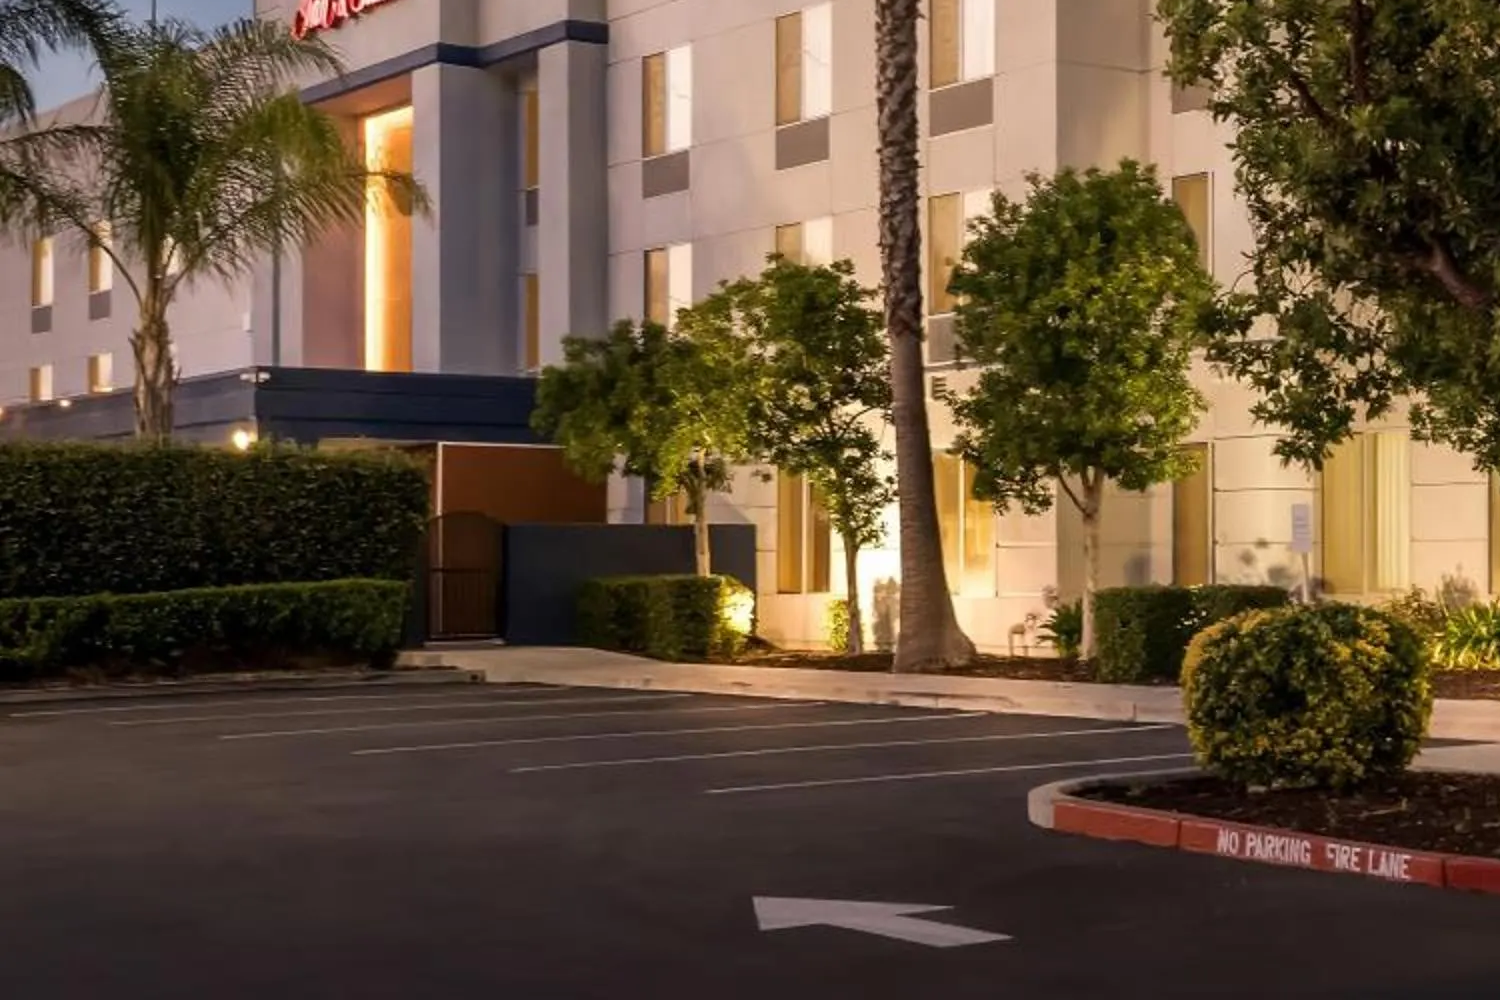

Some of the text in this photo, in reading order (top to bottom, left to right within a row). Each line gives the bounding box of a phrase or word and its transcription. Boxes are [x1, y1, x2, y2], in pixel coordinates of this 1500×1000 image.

[1217, 829, 1413, 880] NO PARKING FIRE LANE
